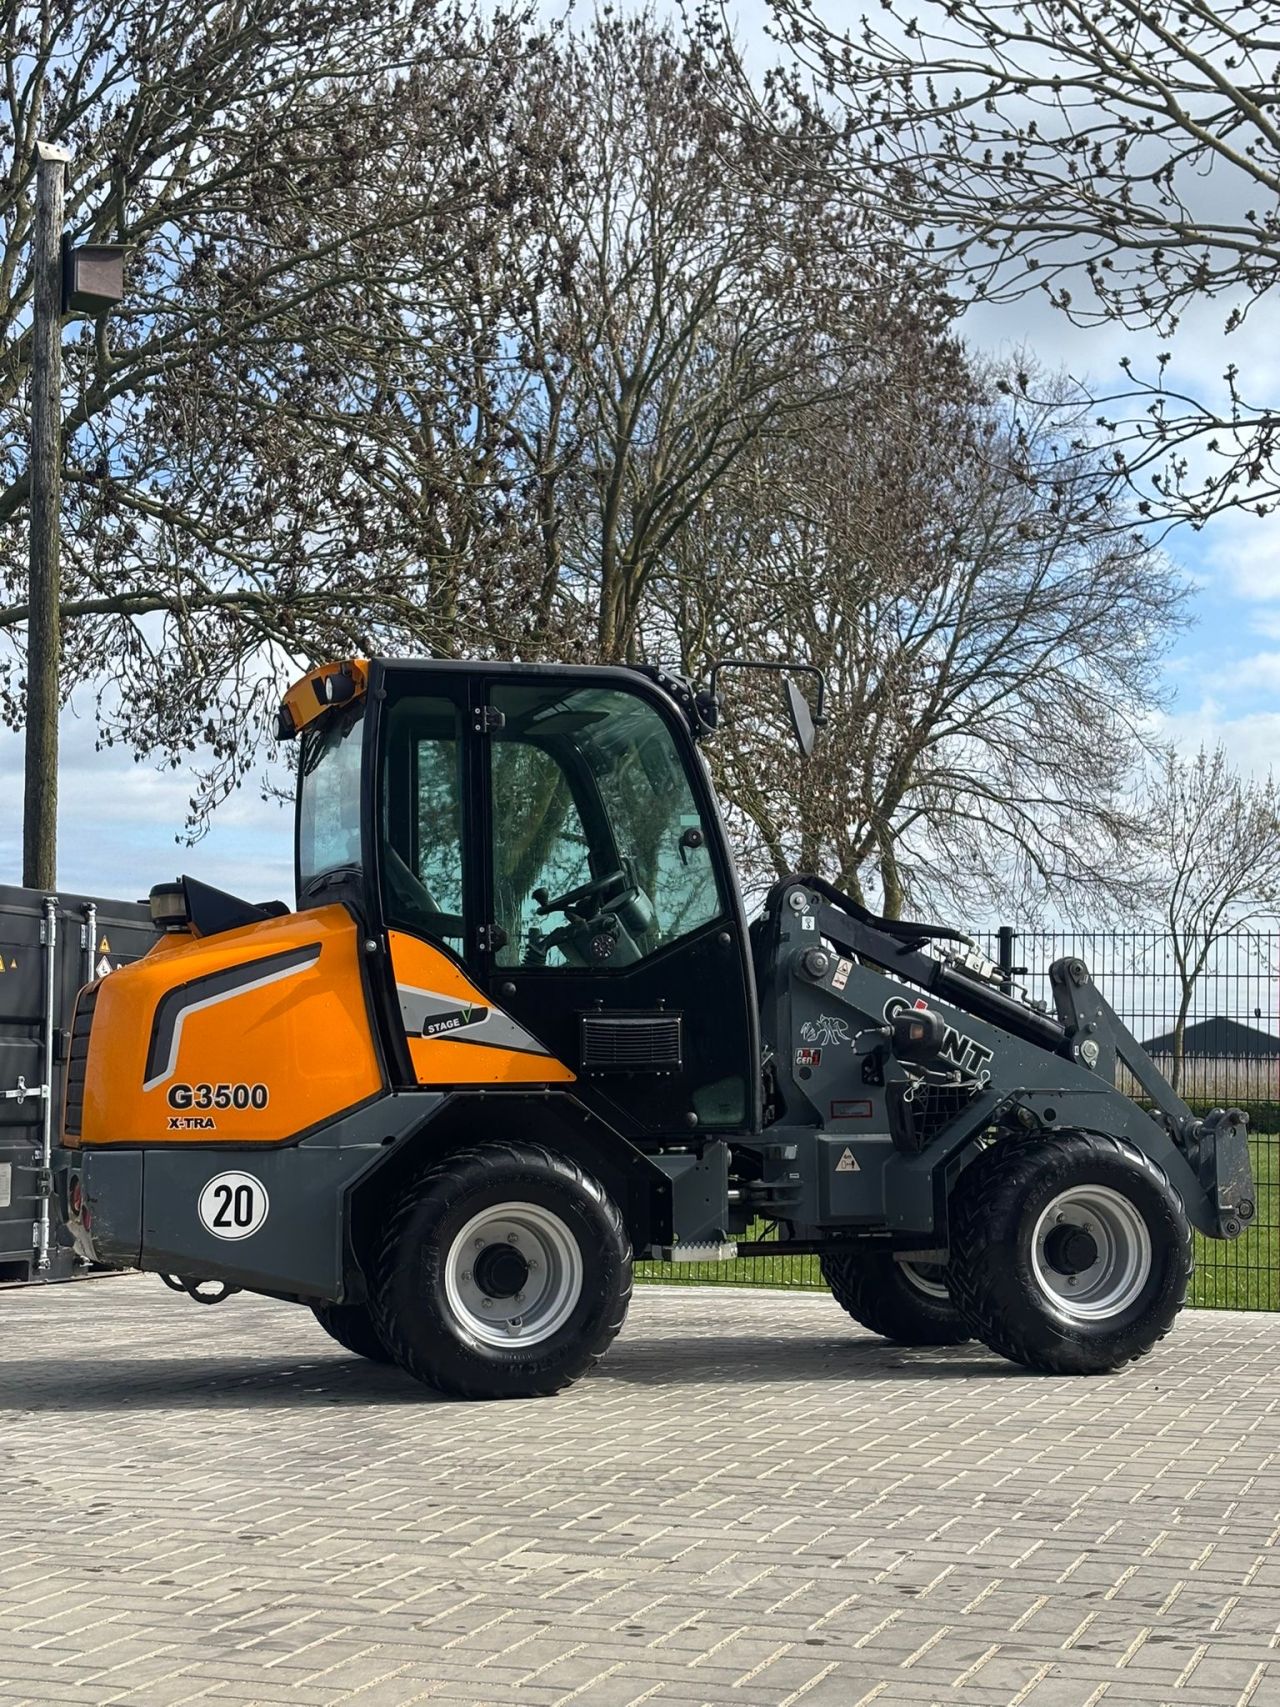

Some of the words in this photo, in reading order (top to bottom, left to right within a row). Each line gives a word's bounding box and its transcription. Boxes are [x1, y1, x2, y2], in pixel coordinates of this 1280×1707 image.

[427, 1018, 461, 1034] STAGE
[167, 1083, 269, 1110] G3500
[167, 1116, 216, 1130] X-TRA
[213, 1184, 253, 1227] 20
